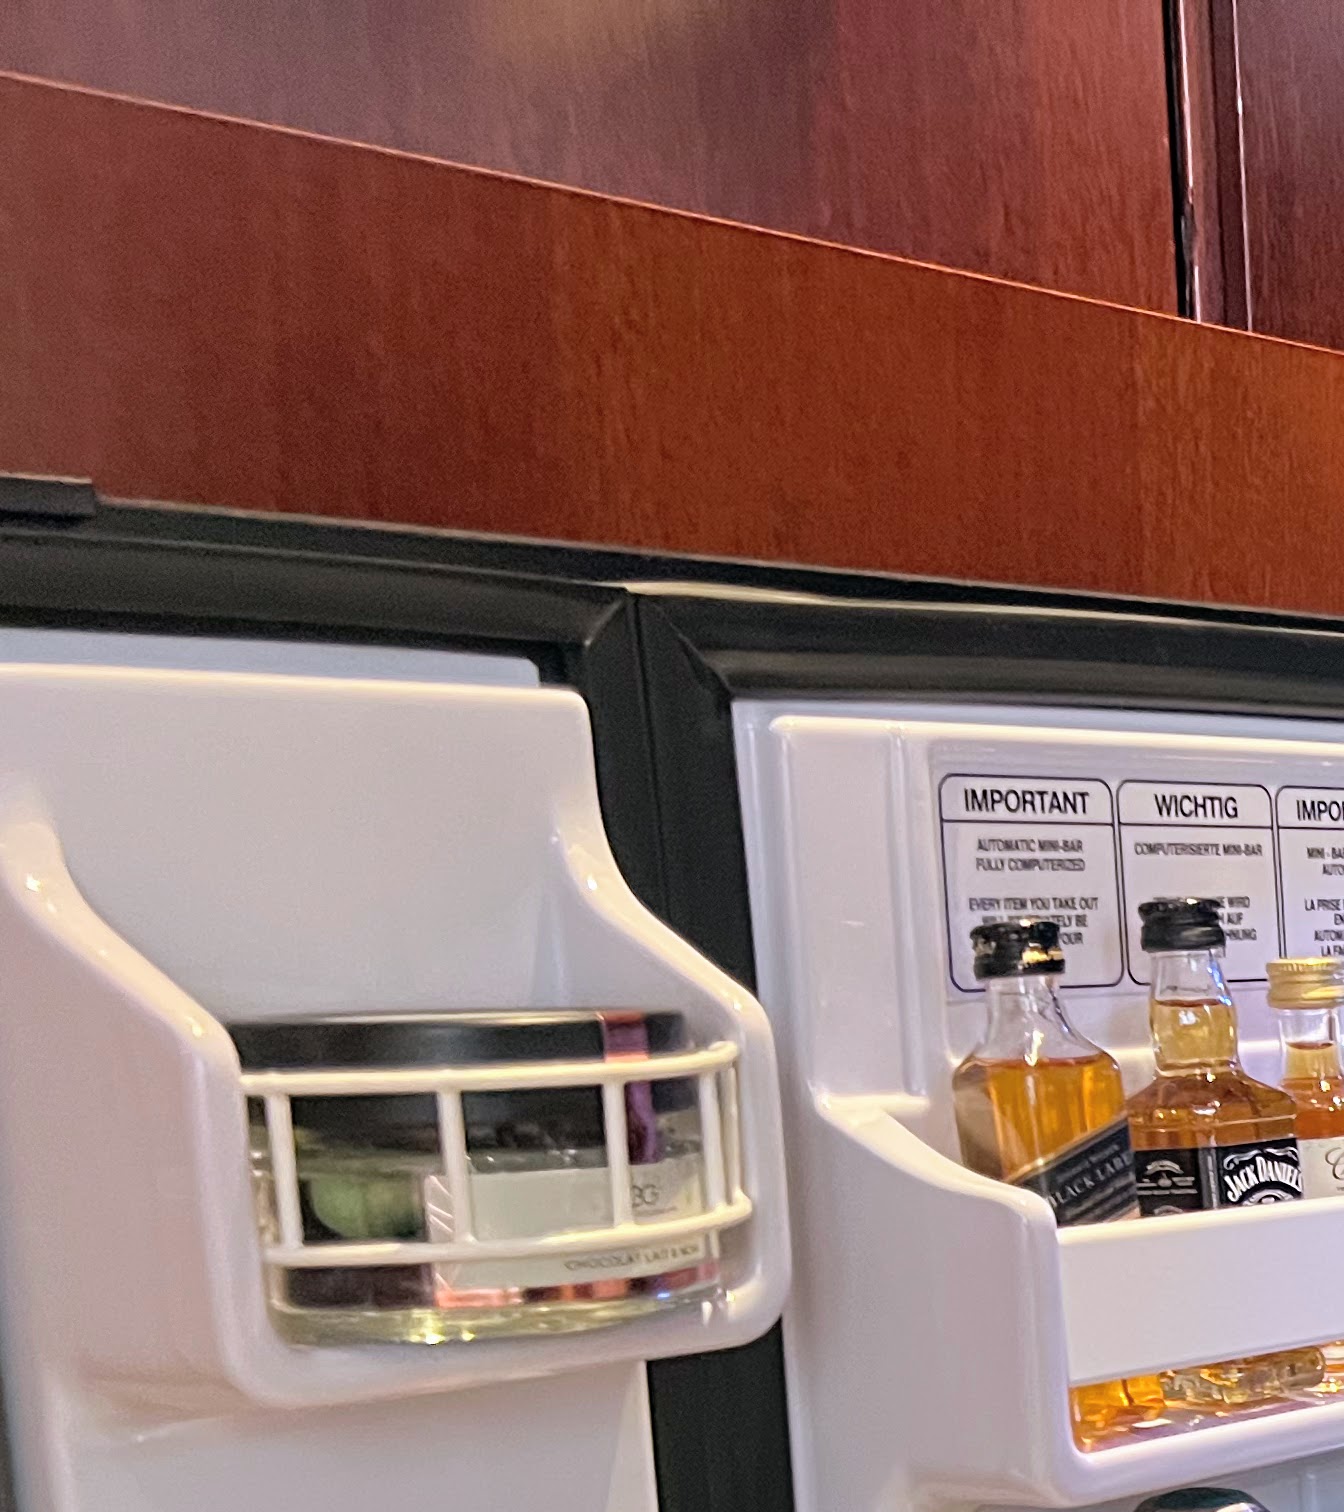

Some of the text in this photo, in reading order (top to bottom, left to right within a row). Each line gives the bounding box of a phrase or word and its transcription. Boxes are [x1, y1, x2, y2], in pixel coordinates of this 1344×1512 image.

[964, 788, 1089, 815] IMPORTANT
[1154, 794, 1239, 818] WICHTIG
[977, 838, 1036, 852] AUTOMATIC
[976, 857, 1085, 871] FULLY COMPUTERIZED
[969, 897, 1098, 911] EVERY ITEM YOU TAKE OUT
[1304, 899, 1315, 911] LA
[1317, 899, 1341, 911] PRISE
[1321, 945, 1331, 957] LA
[1223, 1164, 1256, 1203] JACK
